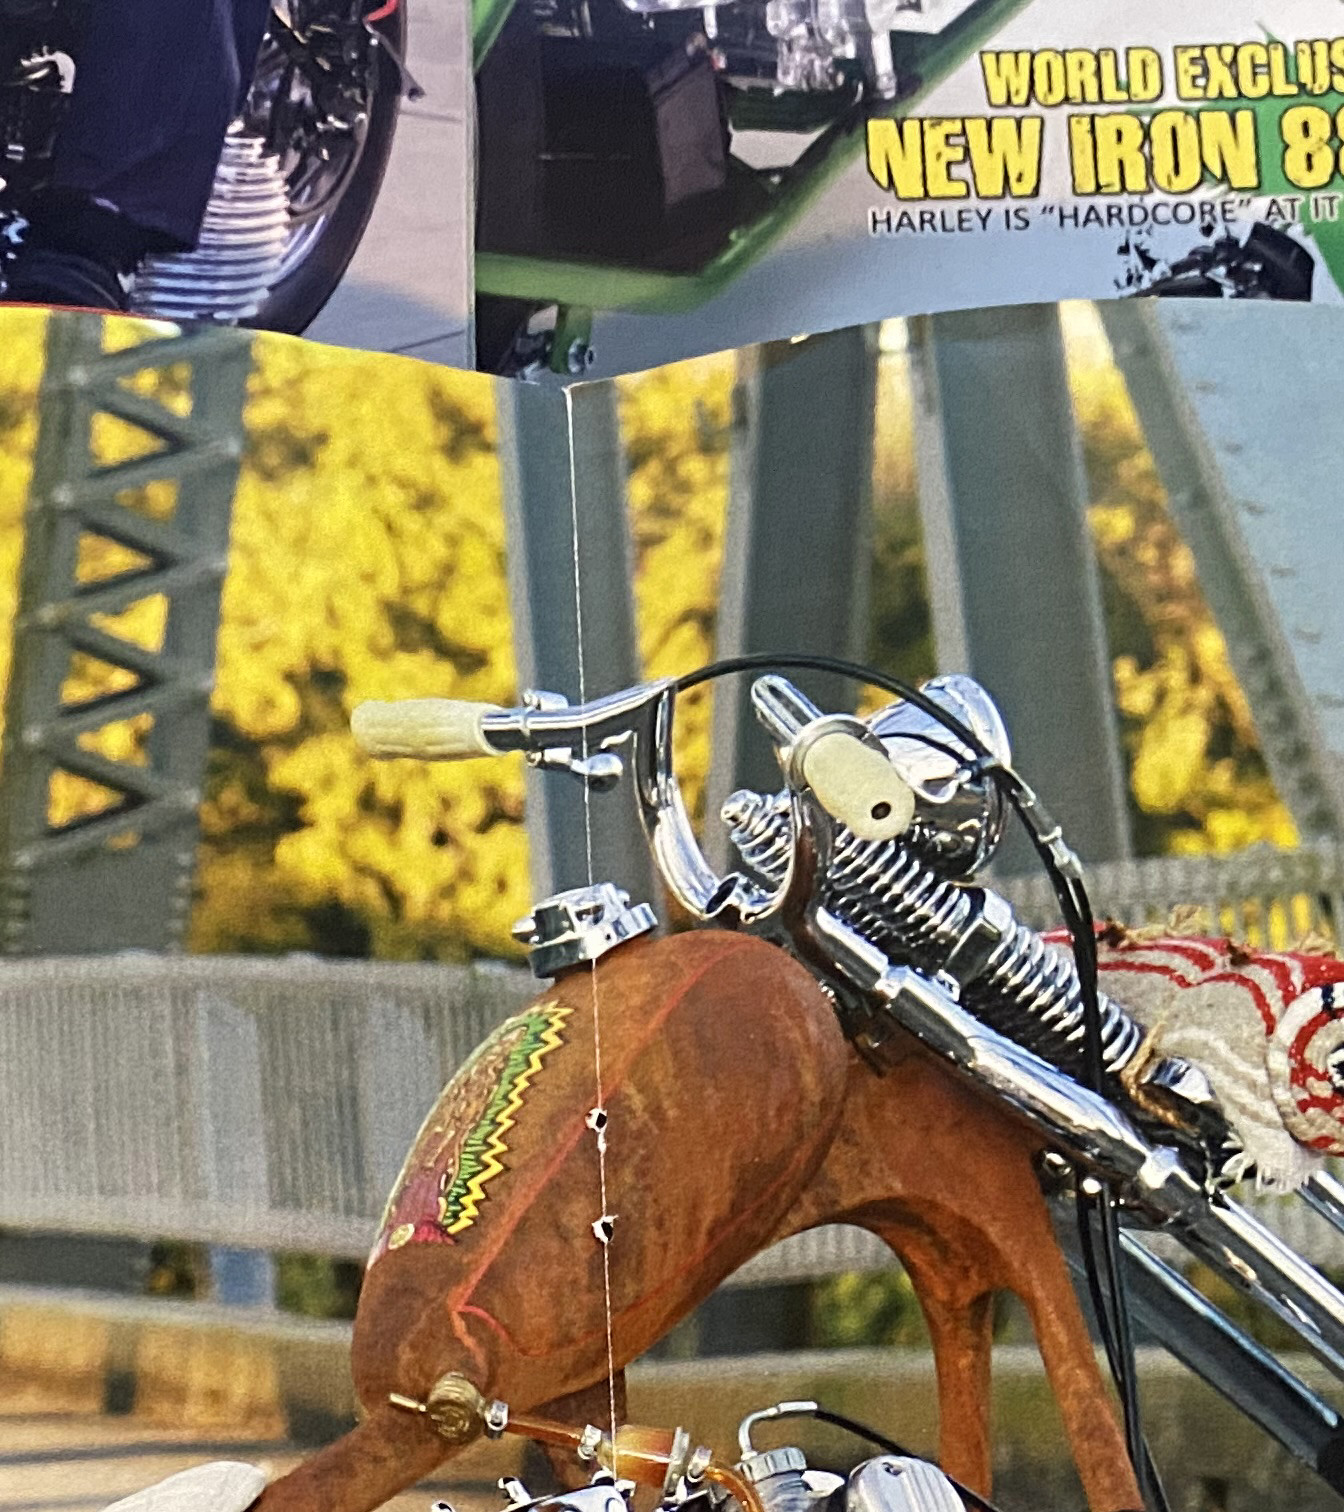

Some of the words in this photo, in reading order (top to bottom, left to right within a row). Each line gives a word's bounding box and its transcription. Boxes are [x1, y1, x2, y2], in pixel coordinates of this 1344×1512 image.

[980, 47, 1164, 107] WORLD
[866, 116, 1043, 200] NEW
[1068, 109, 1260, 196] IRON
[870, 208, 993, 234] HARLEY
[1004, 207, 1031, 231] IS
[1041, 199, 1252, 230] “HARDCORE”
[1265, 198, 1301, 222] AT
[1313, 195, 1342, 220] IT
